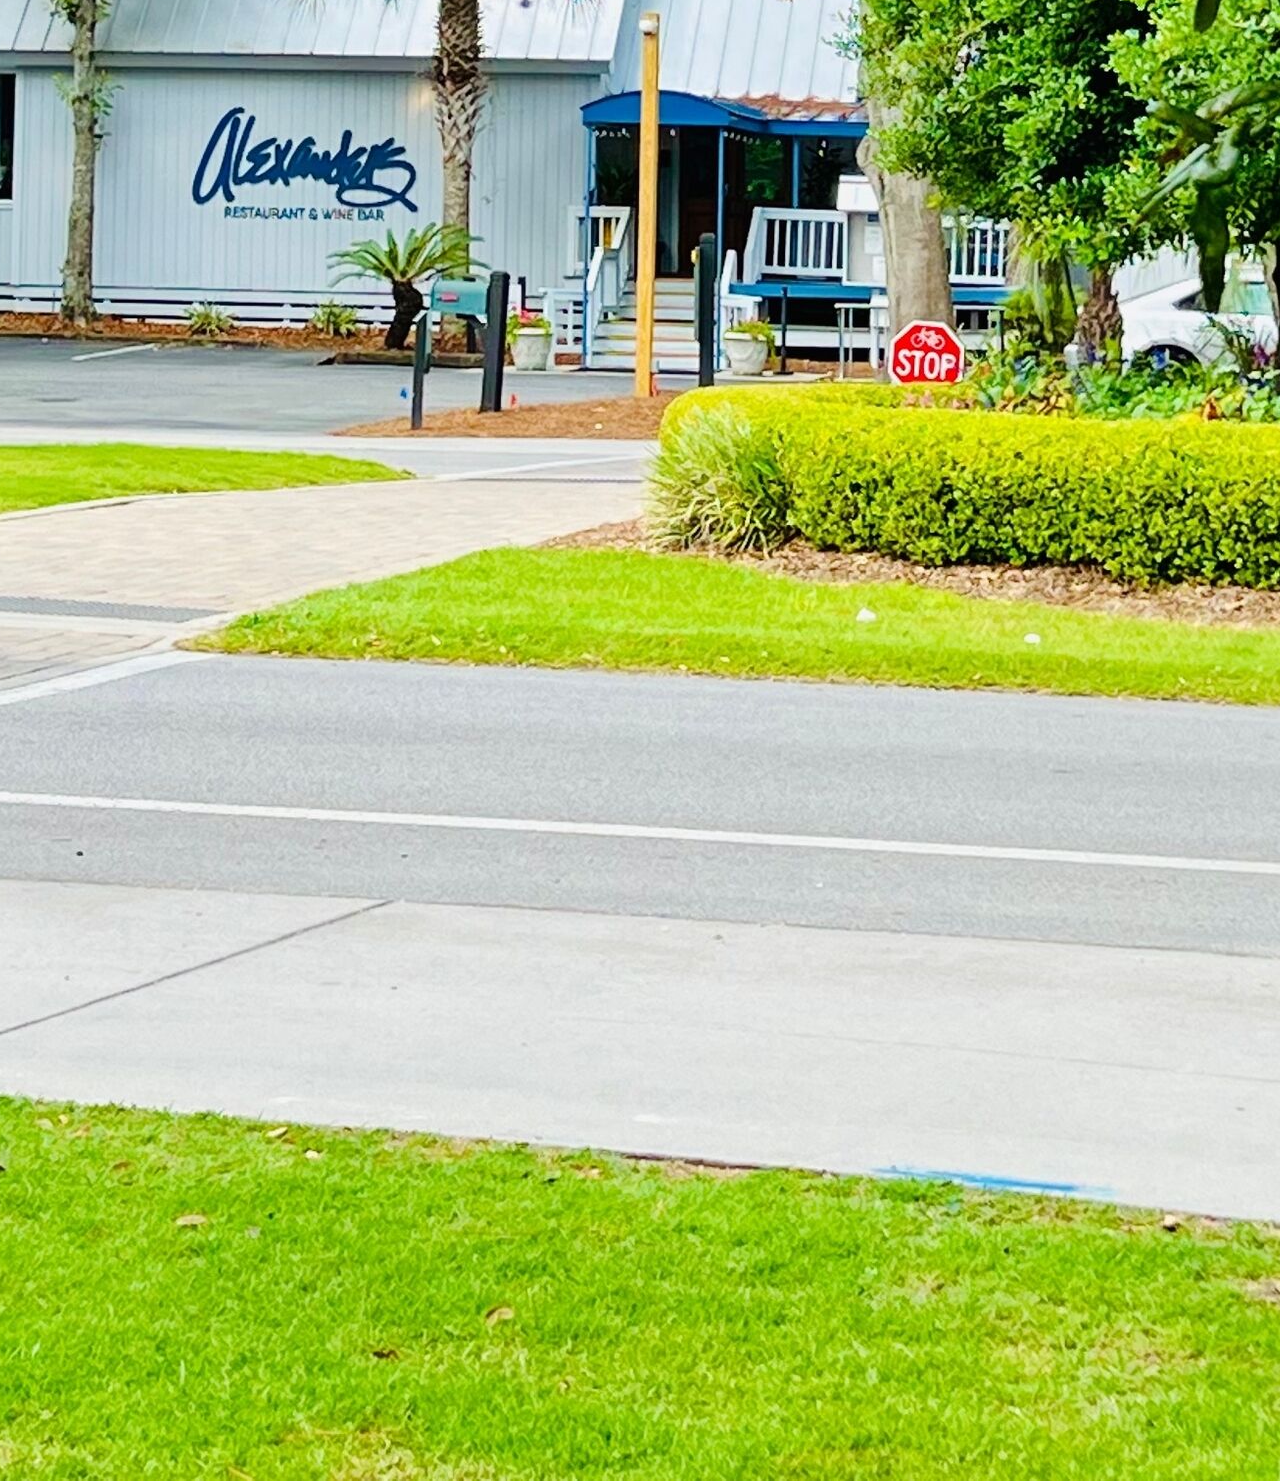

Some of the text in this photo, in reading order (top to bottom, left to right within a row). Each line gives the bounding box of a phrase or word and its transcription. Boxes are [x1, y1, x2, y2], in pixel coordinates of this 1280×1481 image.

[224, 206, 385, 220] RESTAURANT & WINE BAR
[895, 348, 957, 381] STOP
